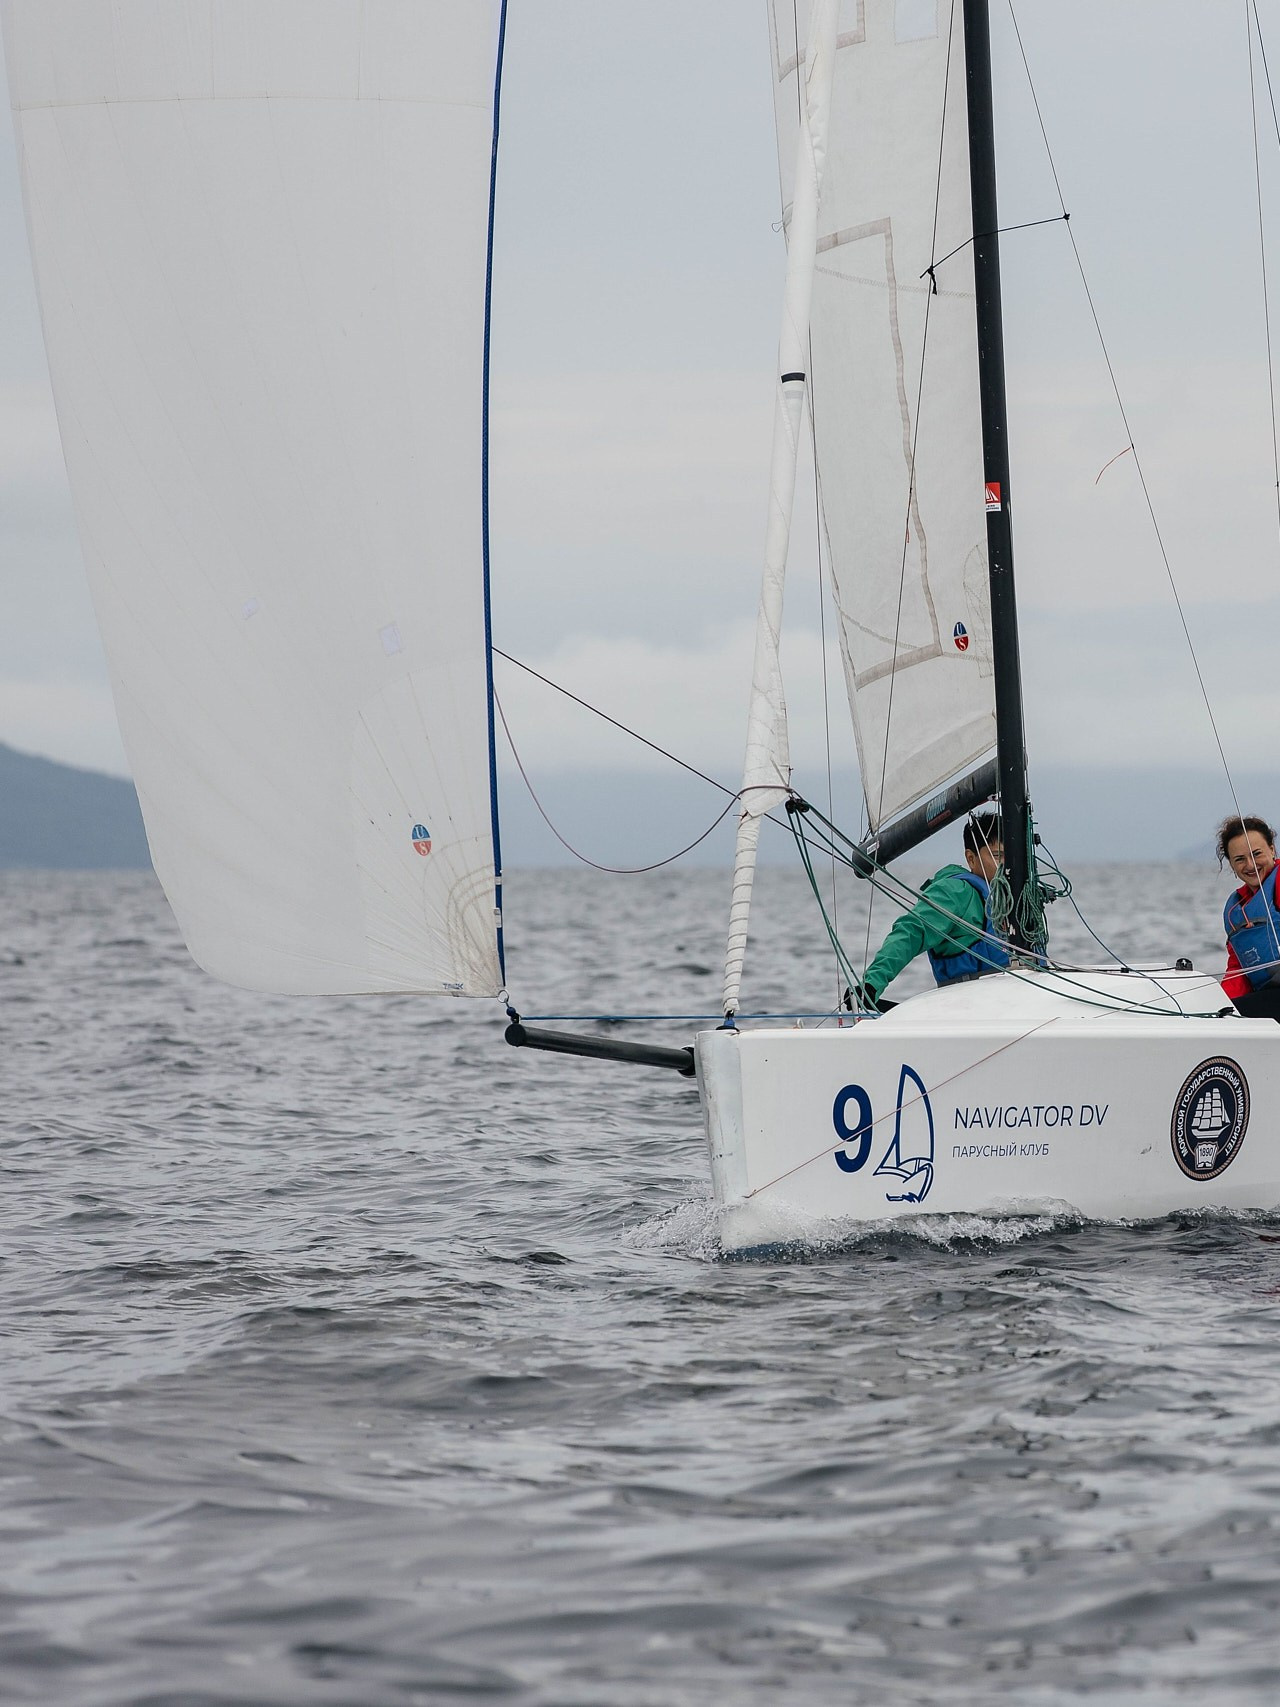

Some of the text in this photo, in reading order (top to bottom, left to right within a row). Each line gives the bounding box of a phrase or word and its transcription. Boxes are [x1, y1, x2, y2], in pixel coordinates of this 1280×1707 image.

[954, 1104, 1109, 1129] NAVIGATOR DV
[1177, 1066, 1243, 1157] МОРСКОЙ ГОСУДАРСТВЕННЫЙ УНИВЕРСИТЕТ
[833, 1083, 873, 1173] 9
[952, 1142, 1050, 1158] ПАРУСНЫЙ КЛУБ
[1200, 1147, 1213, 1157] 1890
